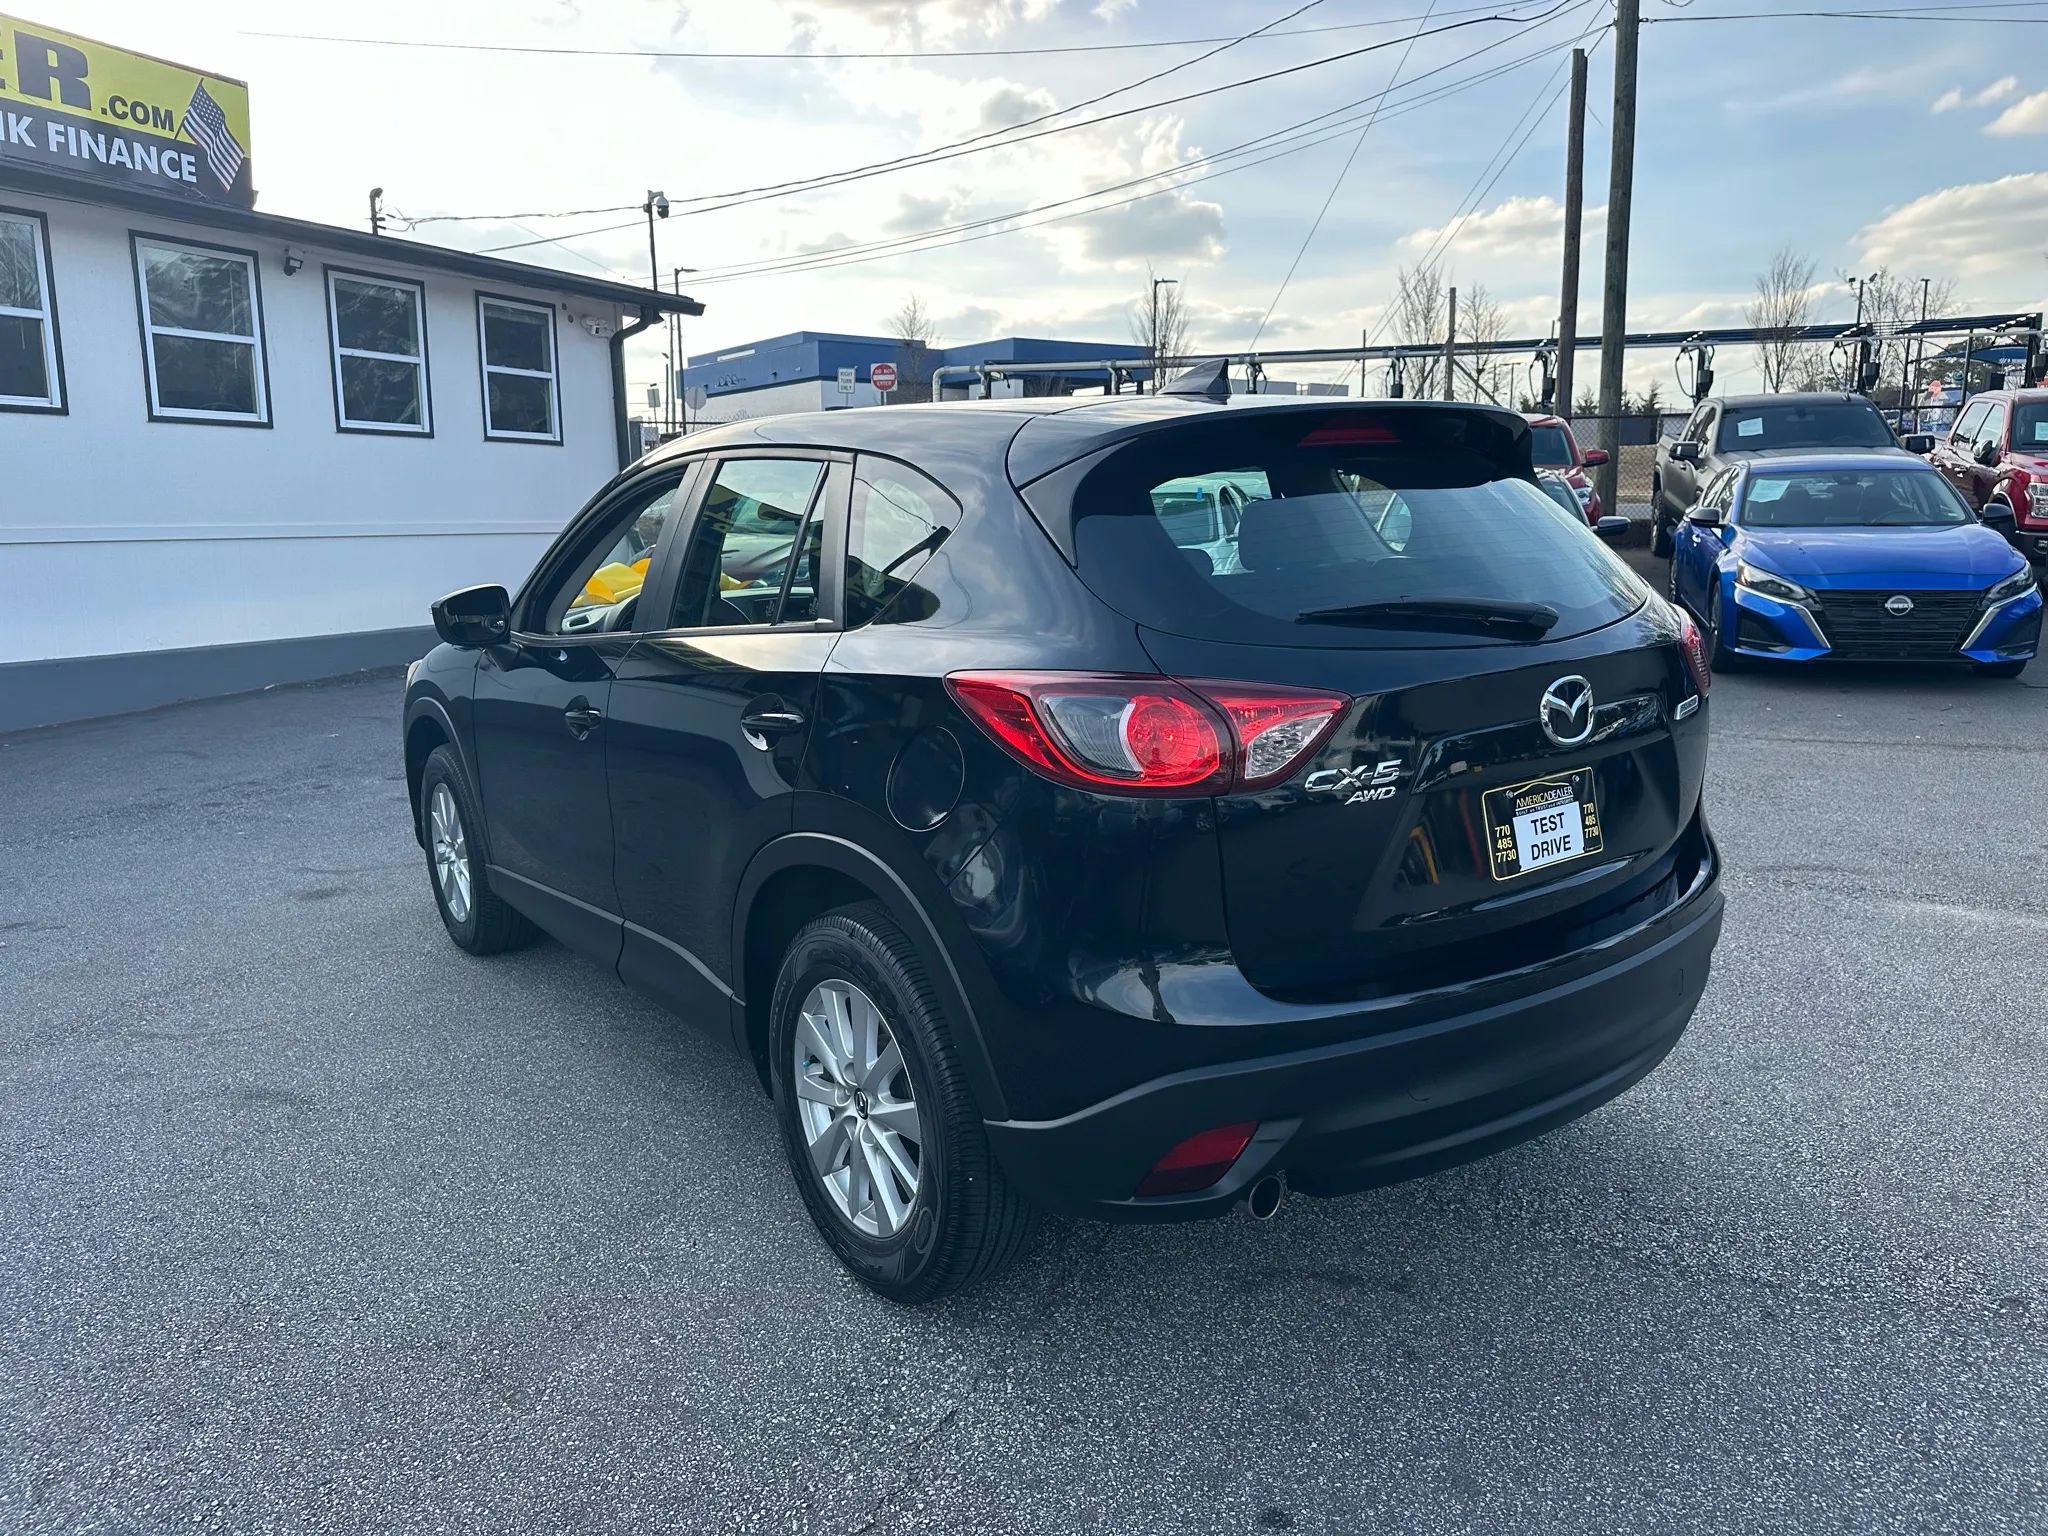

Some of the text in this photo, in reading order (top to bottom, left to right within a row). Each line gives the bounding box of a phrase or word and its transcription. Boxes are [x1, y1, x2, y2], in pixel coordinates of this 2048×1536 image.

[47, 121, 197, 183] FINANCE
[1305, 759, 1402, 792] CX-5
[1344, 786, 1396, 805] AWD
[1516, 786, 1573, 808] AMERICADEALER
[1583, 802, 1594, 815] 770
[1530, 812, 1565, 836] TEST
[1585, 814, 1596, 826] 485
[1495, 824, 1511, 838] 770
[1584, 825, 1599, 839] 7730
[1497, 837, 1513, 850] 485
[1531, 835, 1571, 861] DRIVE
[1496, 849, 1517, 863] 7730
